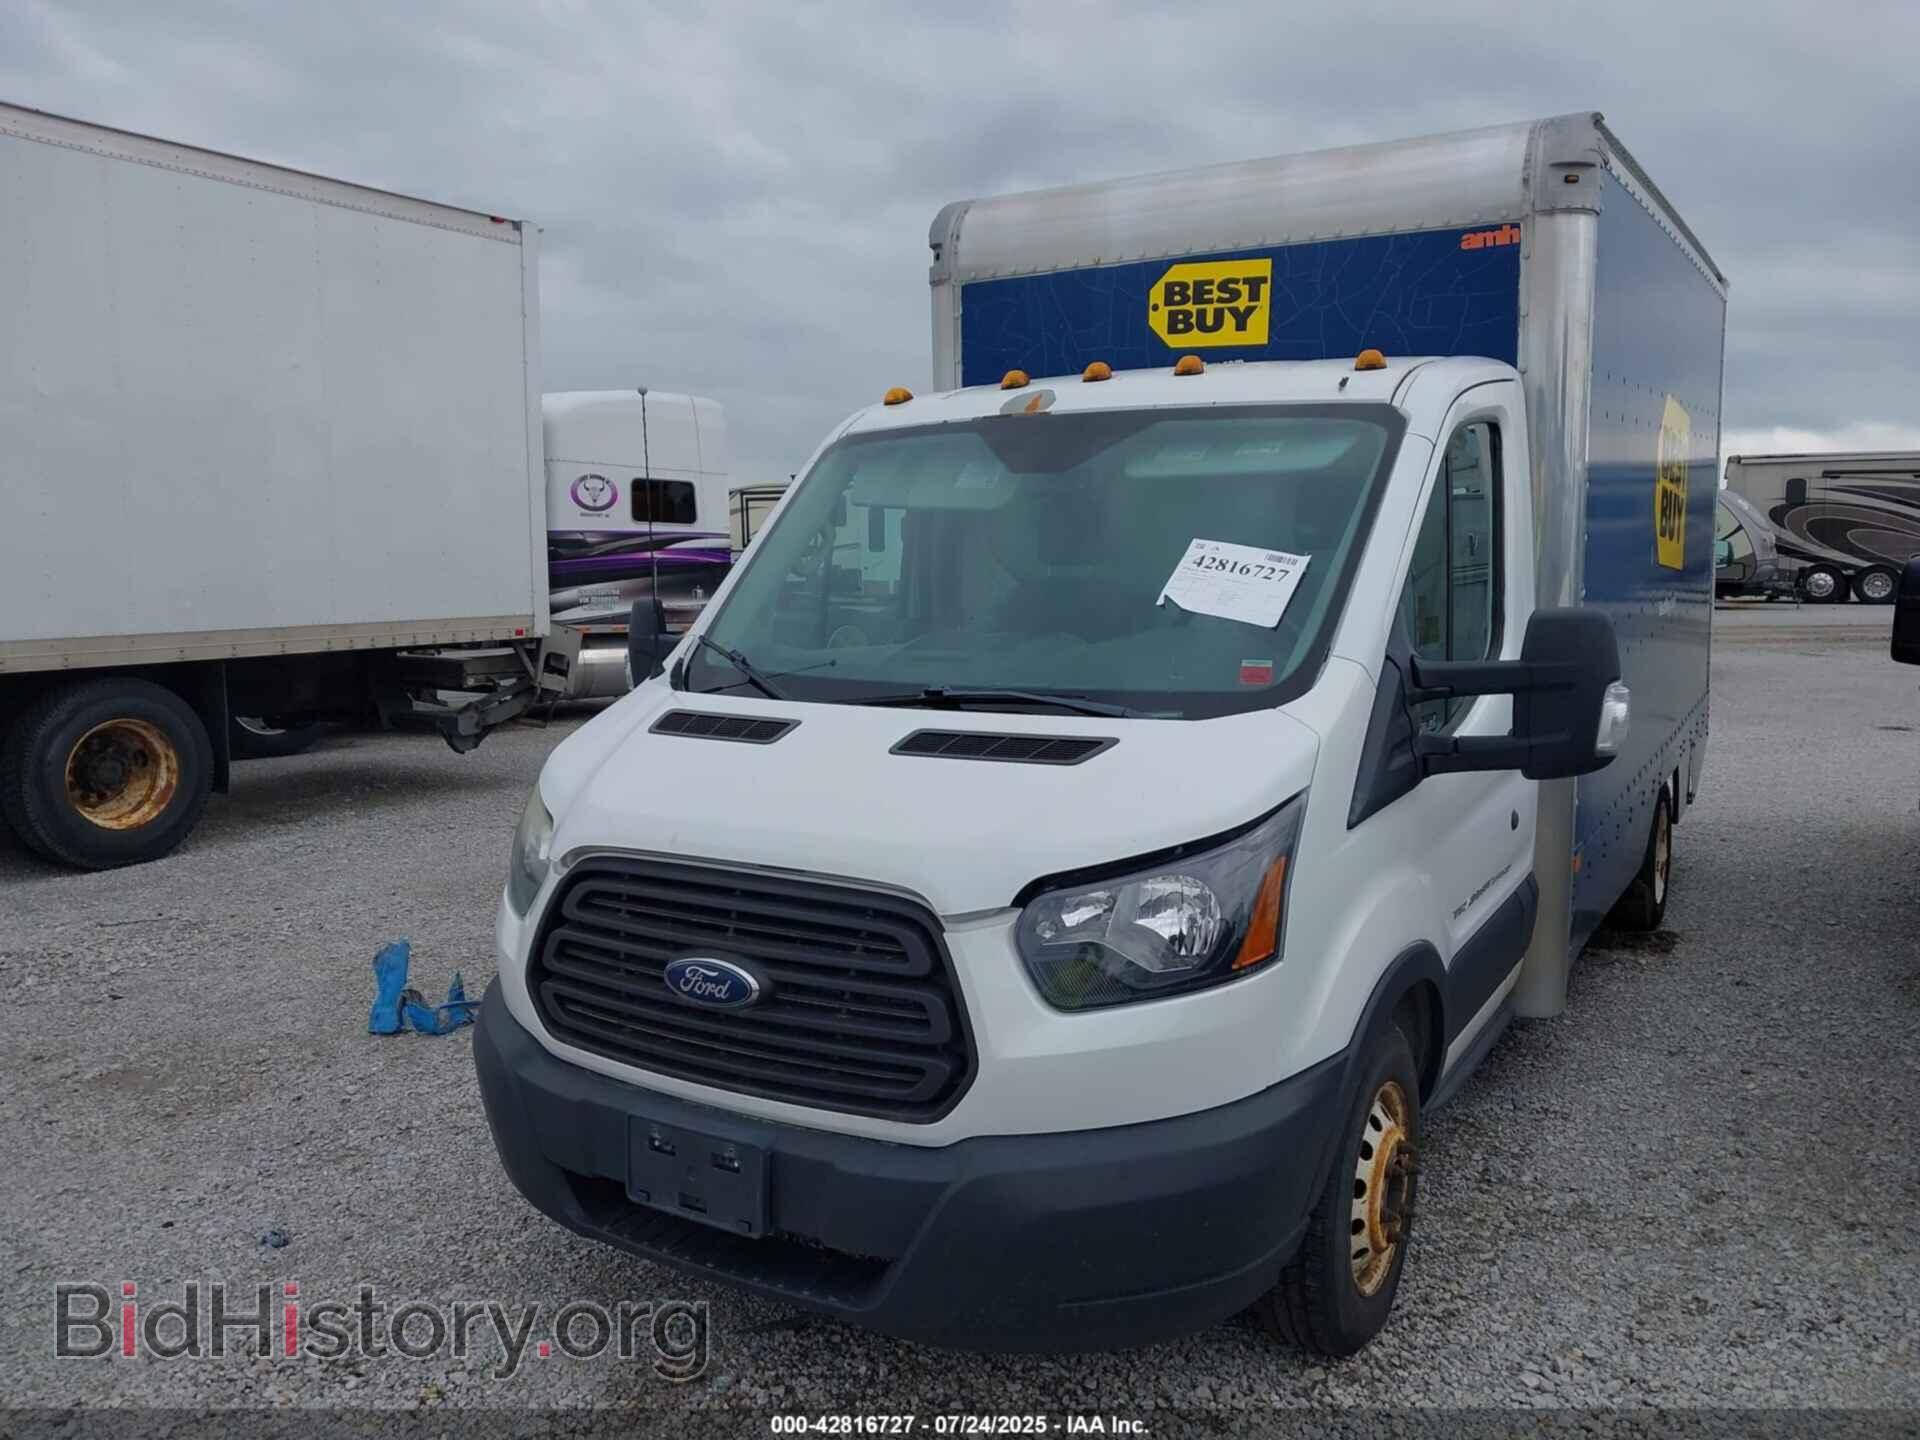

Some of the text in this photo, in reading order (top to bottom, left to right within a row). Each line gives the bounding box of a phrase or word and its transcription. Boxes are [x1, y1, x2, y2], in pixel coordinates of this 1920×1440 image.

[1164, 276, 1268, 306] BEST
[1167, 305, 1258, 334] BUY
[1659, 486, 1685, 544] BUY
[1193, 554, 1290, 582] 42816727
[679, 966, 731, 1000] Ford
